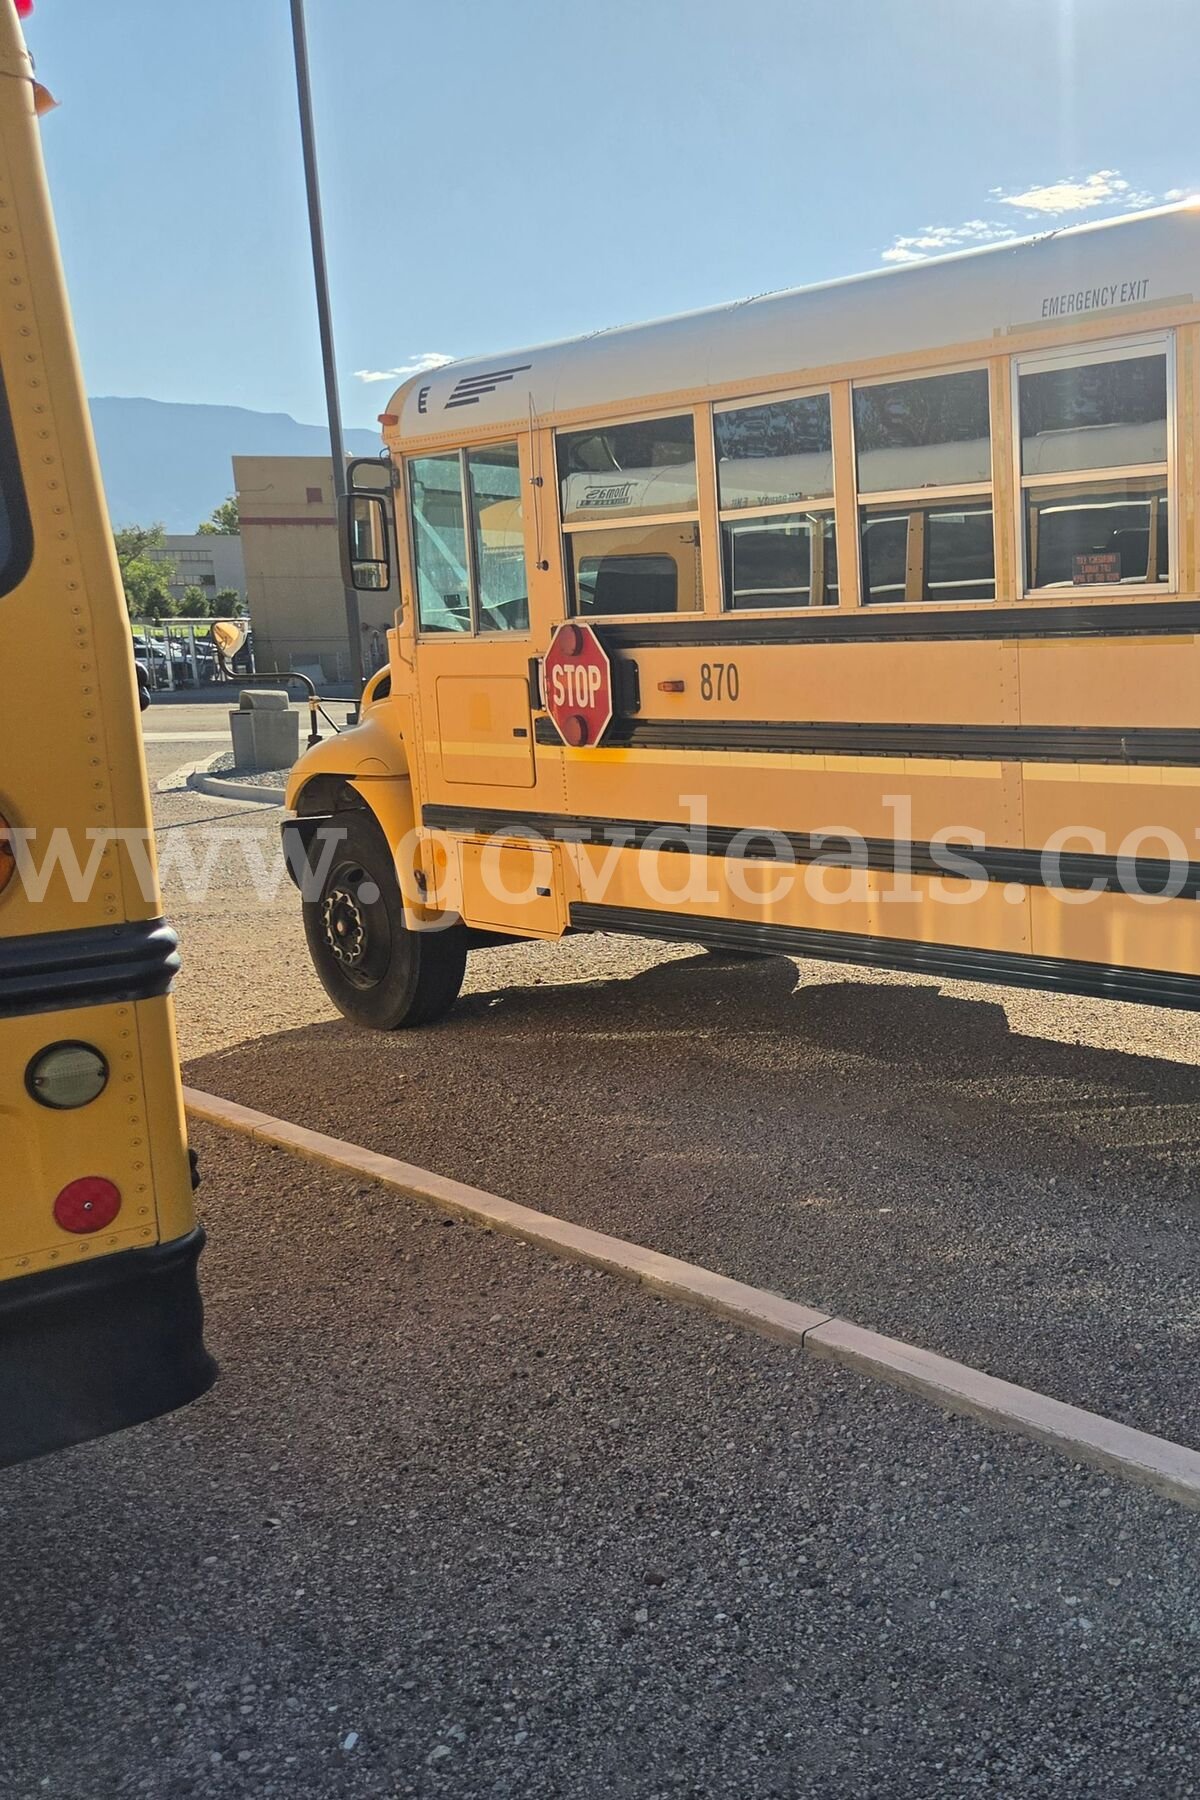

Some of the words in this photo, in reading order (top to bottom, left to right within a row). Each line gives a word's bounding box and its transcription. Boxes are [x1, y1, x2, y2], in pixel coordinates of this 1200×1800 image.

[1042, 285, 1118, 317] EMERGENCY
[1120, 279, 1149, 302] EXIT
[552, 664, 601, 708] STOP
[700, 663, 739, 701] 870
